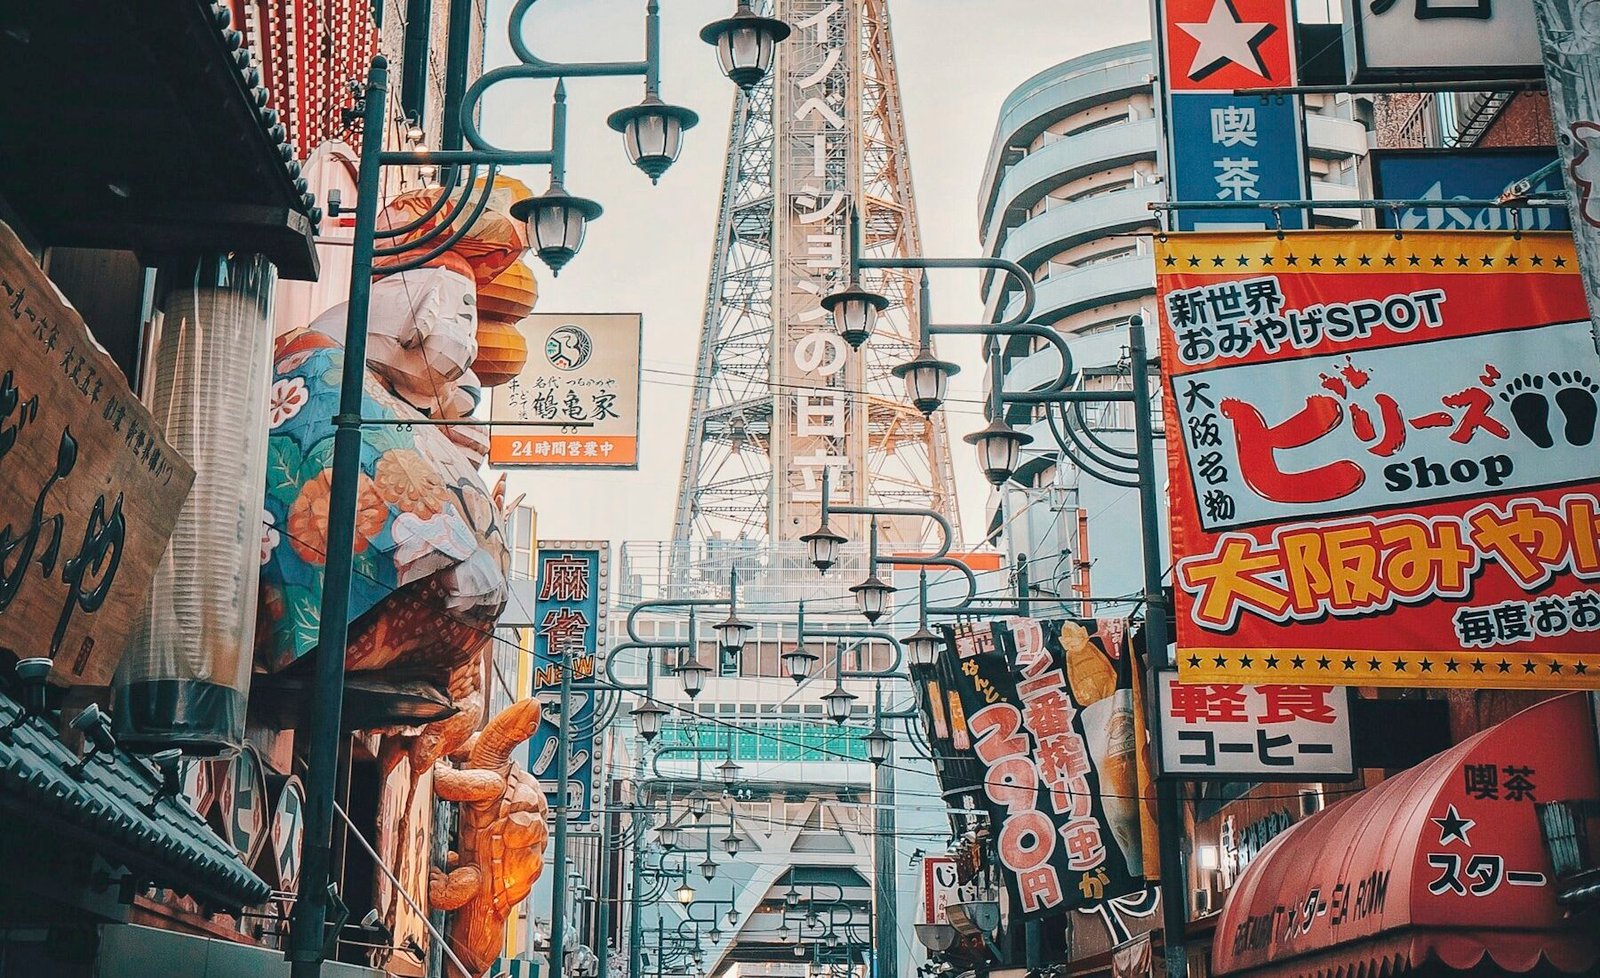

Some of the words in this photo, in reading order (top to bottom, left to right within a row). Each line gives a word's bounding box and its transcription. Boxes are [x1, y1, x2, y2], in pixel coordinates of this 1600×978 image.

[1210, 105, 1261, 200] 喫茶
[1400, 180, 1552, 230] Asahi
[1168, 279, 1282, 328] 新世界
[1178, 291, 1443, 362] おみやげSPOT
[532, 387, 621, 421] 鶴亀家
[512, 440, 614, 457] 24時間営業中
[1182, 379, 1236, 521] 大阪名物
[1220, 355, 1511, 504] ビリーズ
[538, 553, 591, 655] 麻雀
[1169, 680, 1337, 724] 軽食
[1177, 729, 1334, 766] コーヒー
[1463, 764, 1537, 801] 喫茶
[968, 702, 1064, 914] 290円
[1427, 853, 1548, 897] スター
